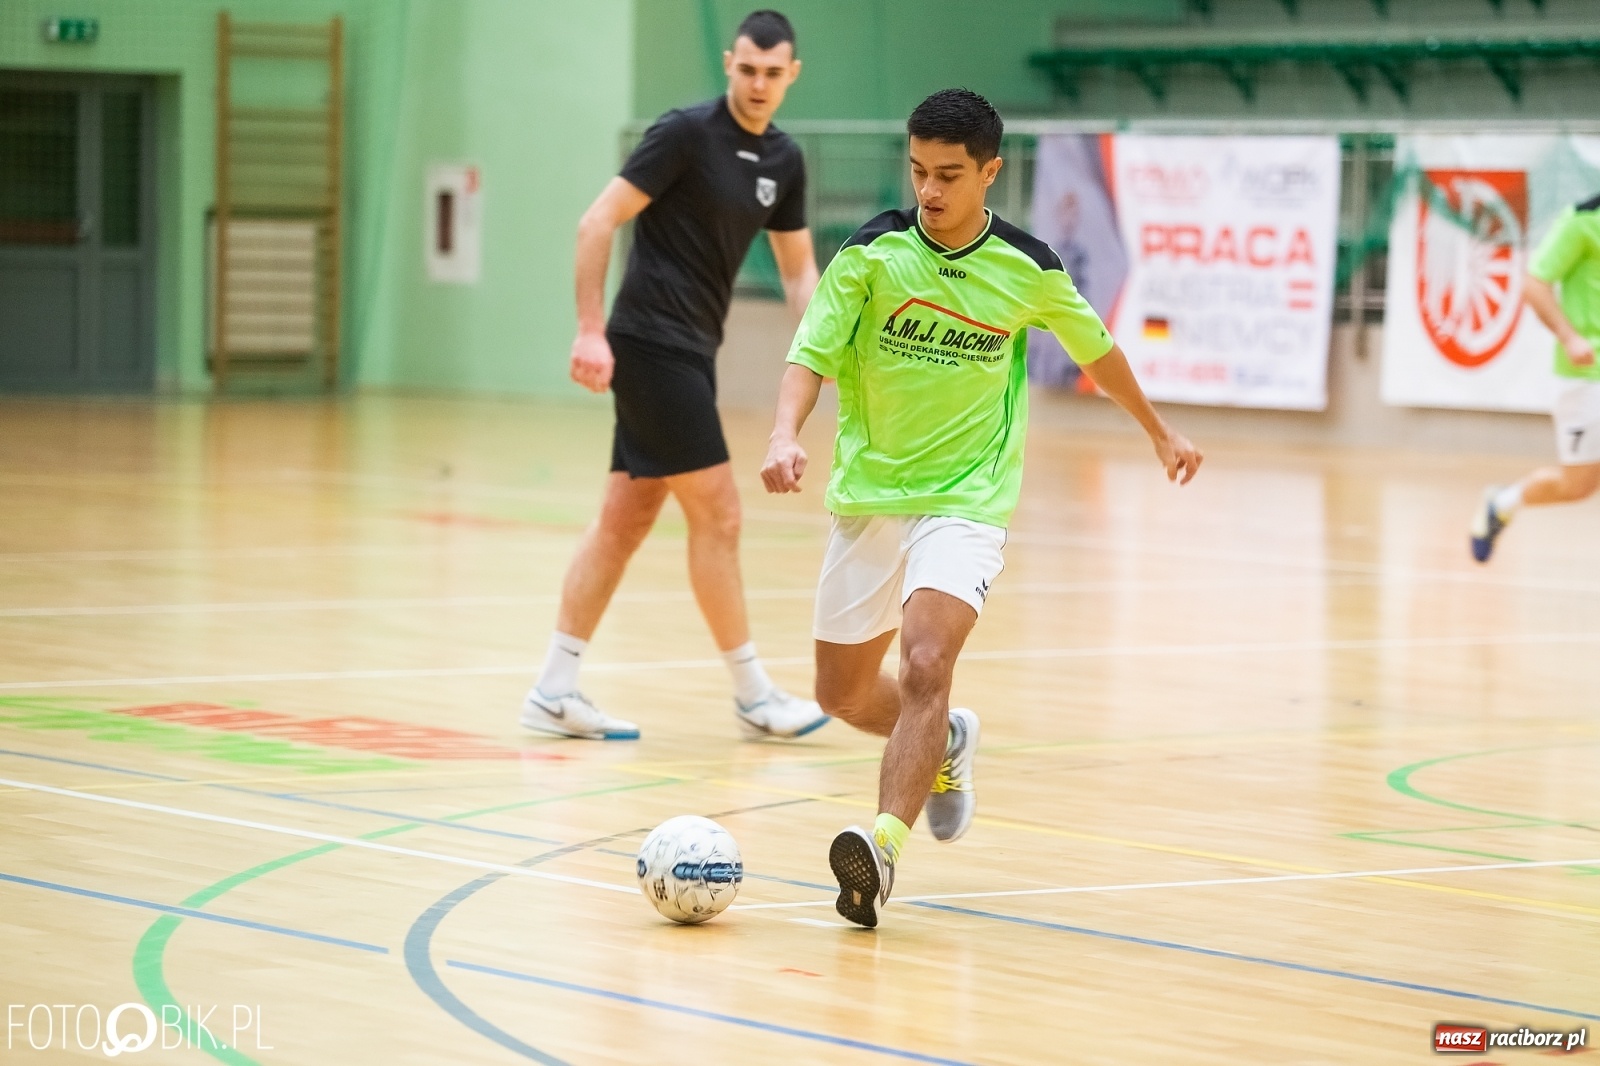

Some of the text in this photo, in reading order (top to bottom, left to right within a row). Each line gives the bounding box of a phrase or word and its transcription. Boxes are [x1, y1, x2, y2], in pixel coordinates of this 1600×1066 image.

[1140, 223, 1315, 268] PRACA
[938, 267, 967, 279] JAKO
[882, 315, 939, 344] A.M.J.
[879, 344, 960, 367] SYRYNIA
